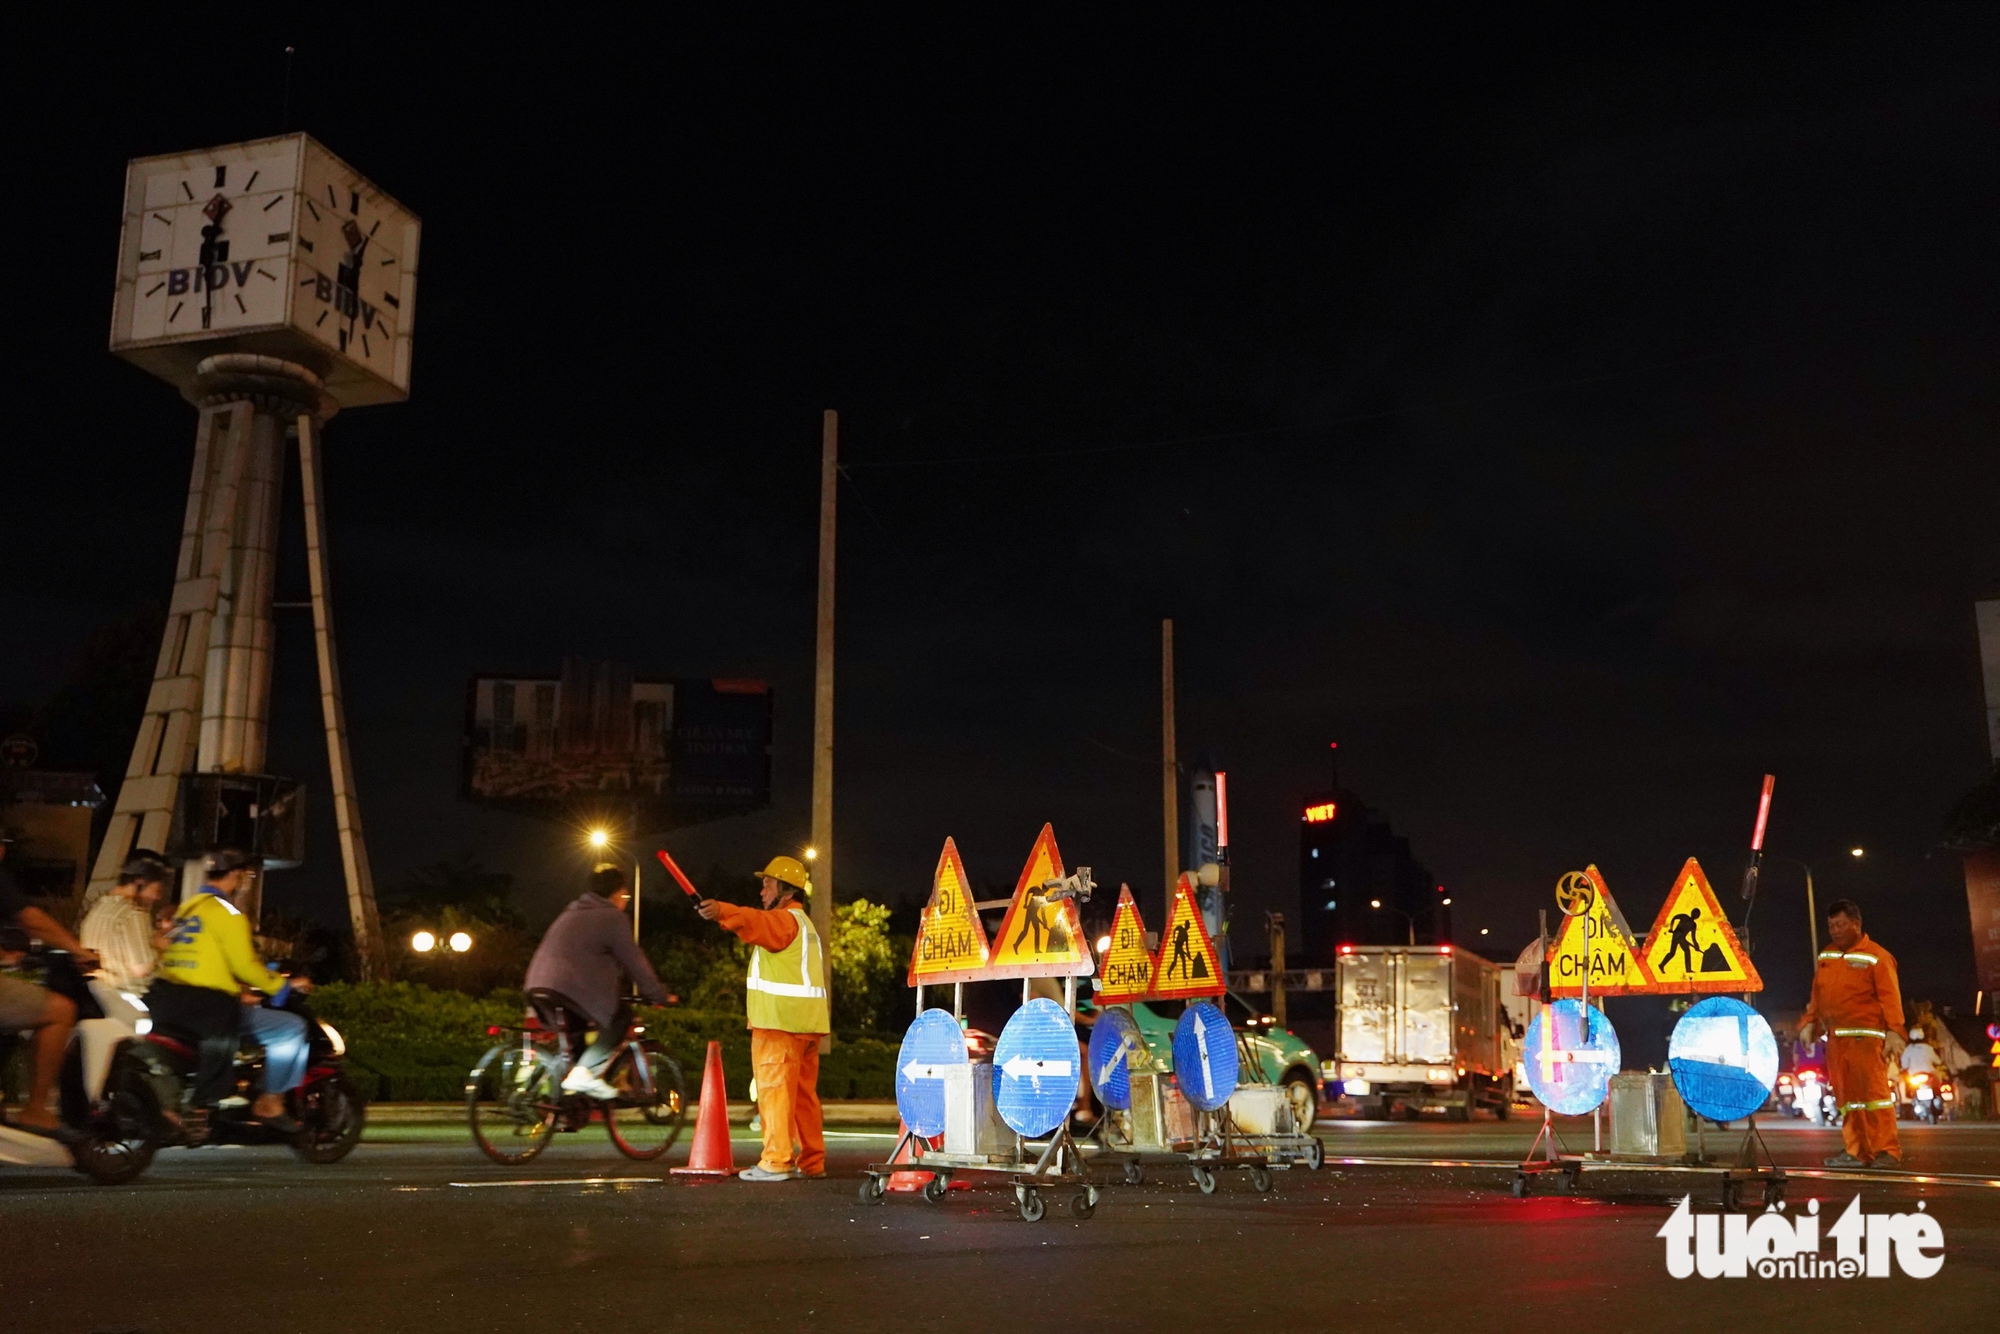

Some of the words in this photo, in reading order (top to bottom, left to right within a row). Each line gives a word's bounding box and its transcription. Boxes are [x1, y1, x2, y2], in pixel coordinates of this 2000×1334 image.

[168, 259, 255, 297] BIDV
[316, 272, 378, 330] BIDV
[939, 889, 956, 916] ĐI
[1121, 928, 1134, 949] ĐI
